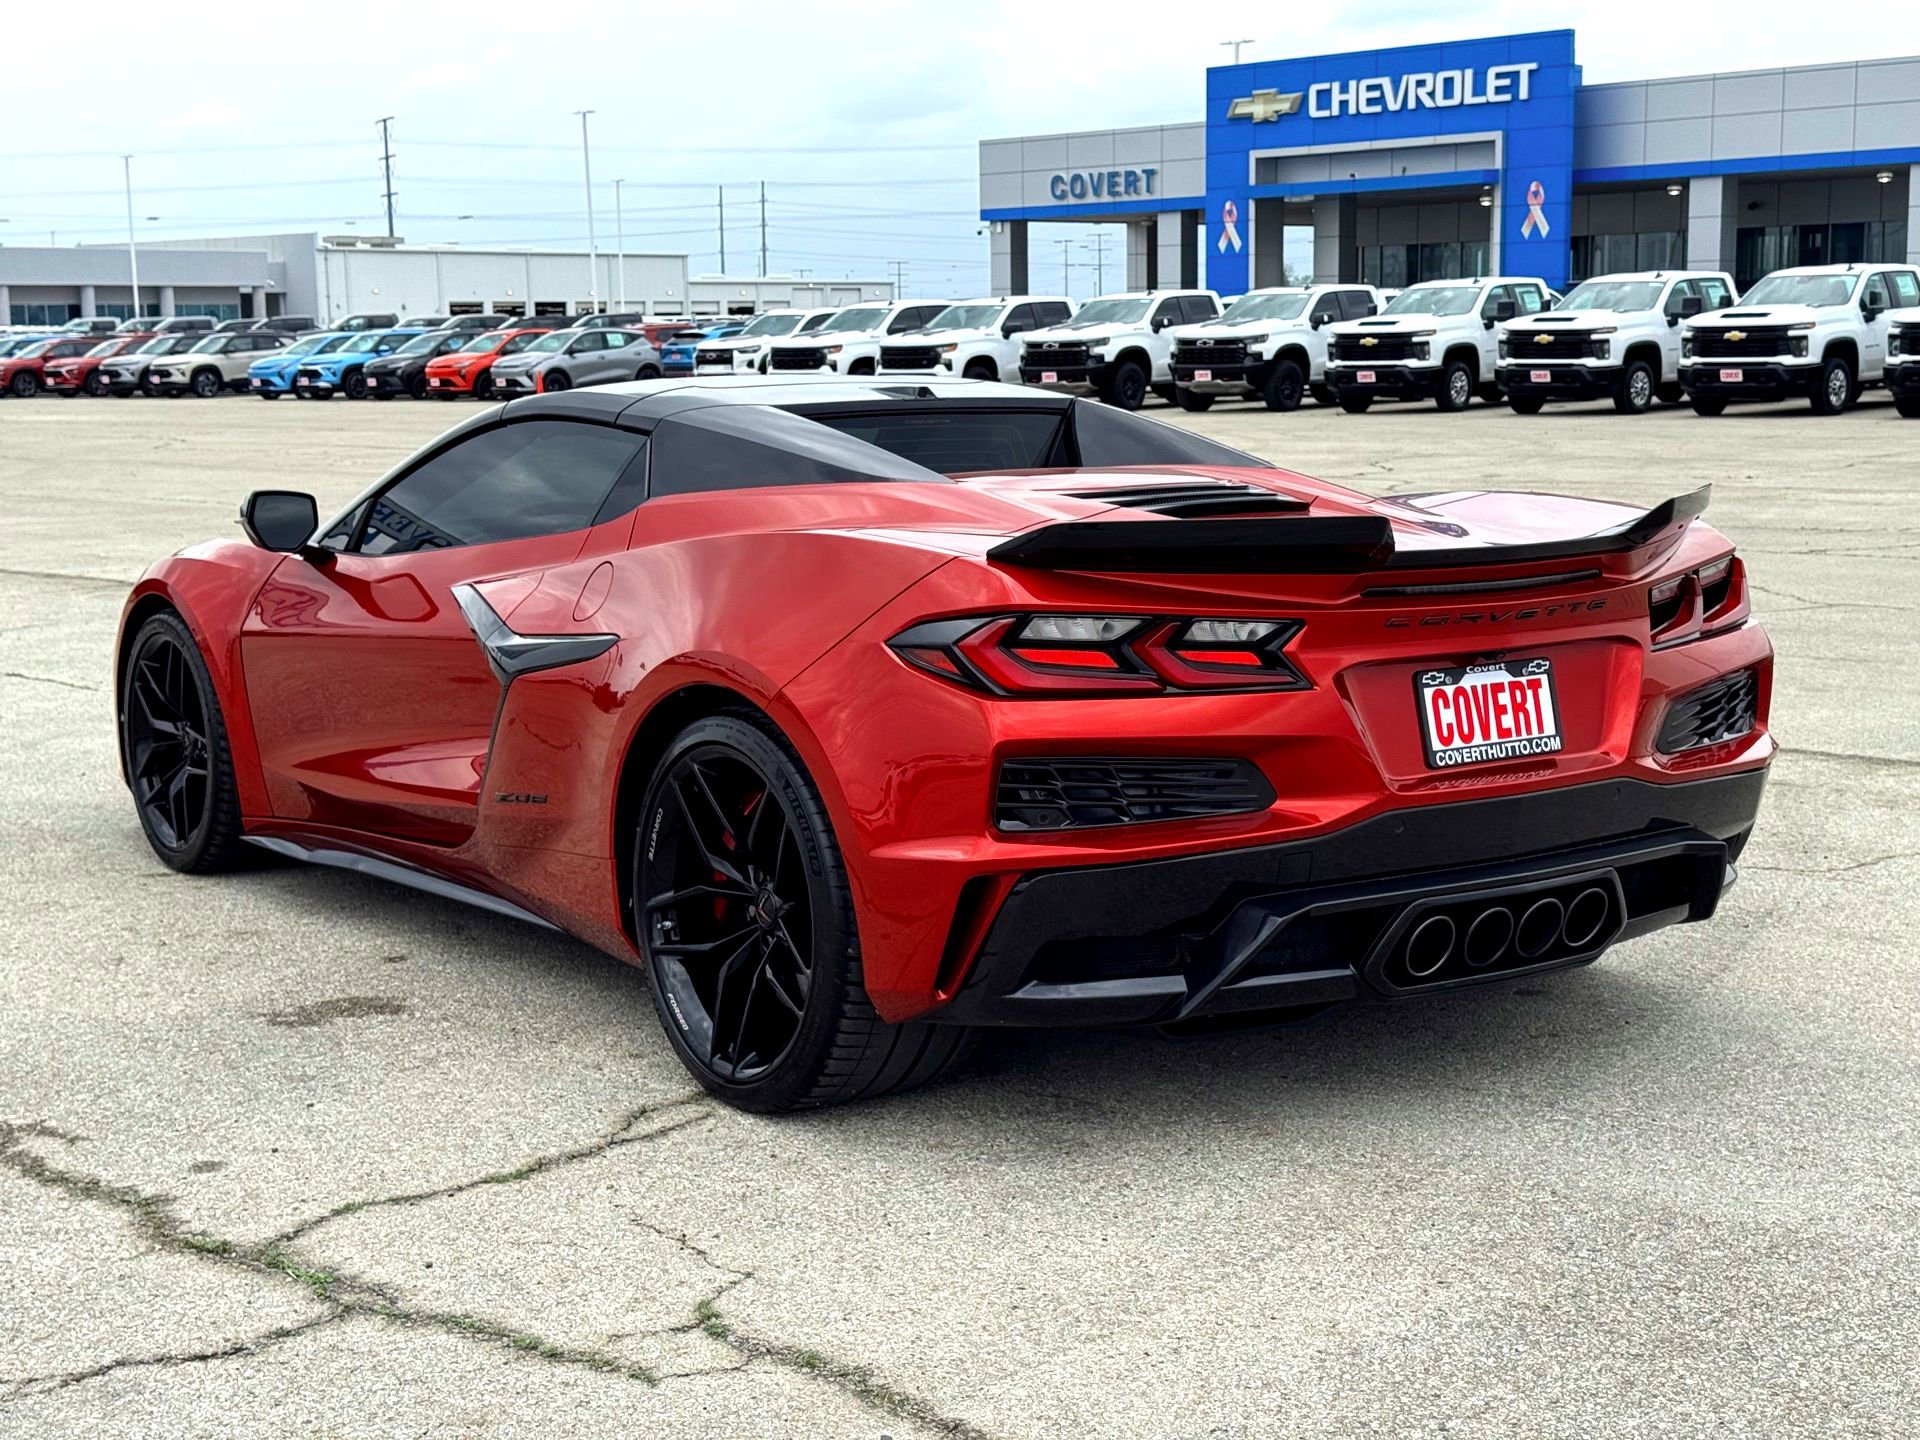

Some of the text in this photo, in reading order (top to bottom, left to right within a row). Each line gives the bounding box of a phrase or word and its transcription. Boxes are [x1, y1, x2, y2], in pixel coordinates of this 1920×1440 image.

[1308, 62, 1539, 118] CHEVROLET
[1050, 168, 1157, 201] COVERT
[1383, 598, 1608, 628] CORVETTE
[1465, 662, 1506, 674] Covert
[1431, 677, 1545, 748] COVERT
[1435, 736, 1562, 767] COVERTHUTTO.COM
[647, 807, 664, 862] CORVETTE
[667, 993, 689, 1031] FORGED
